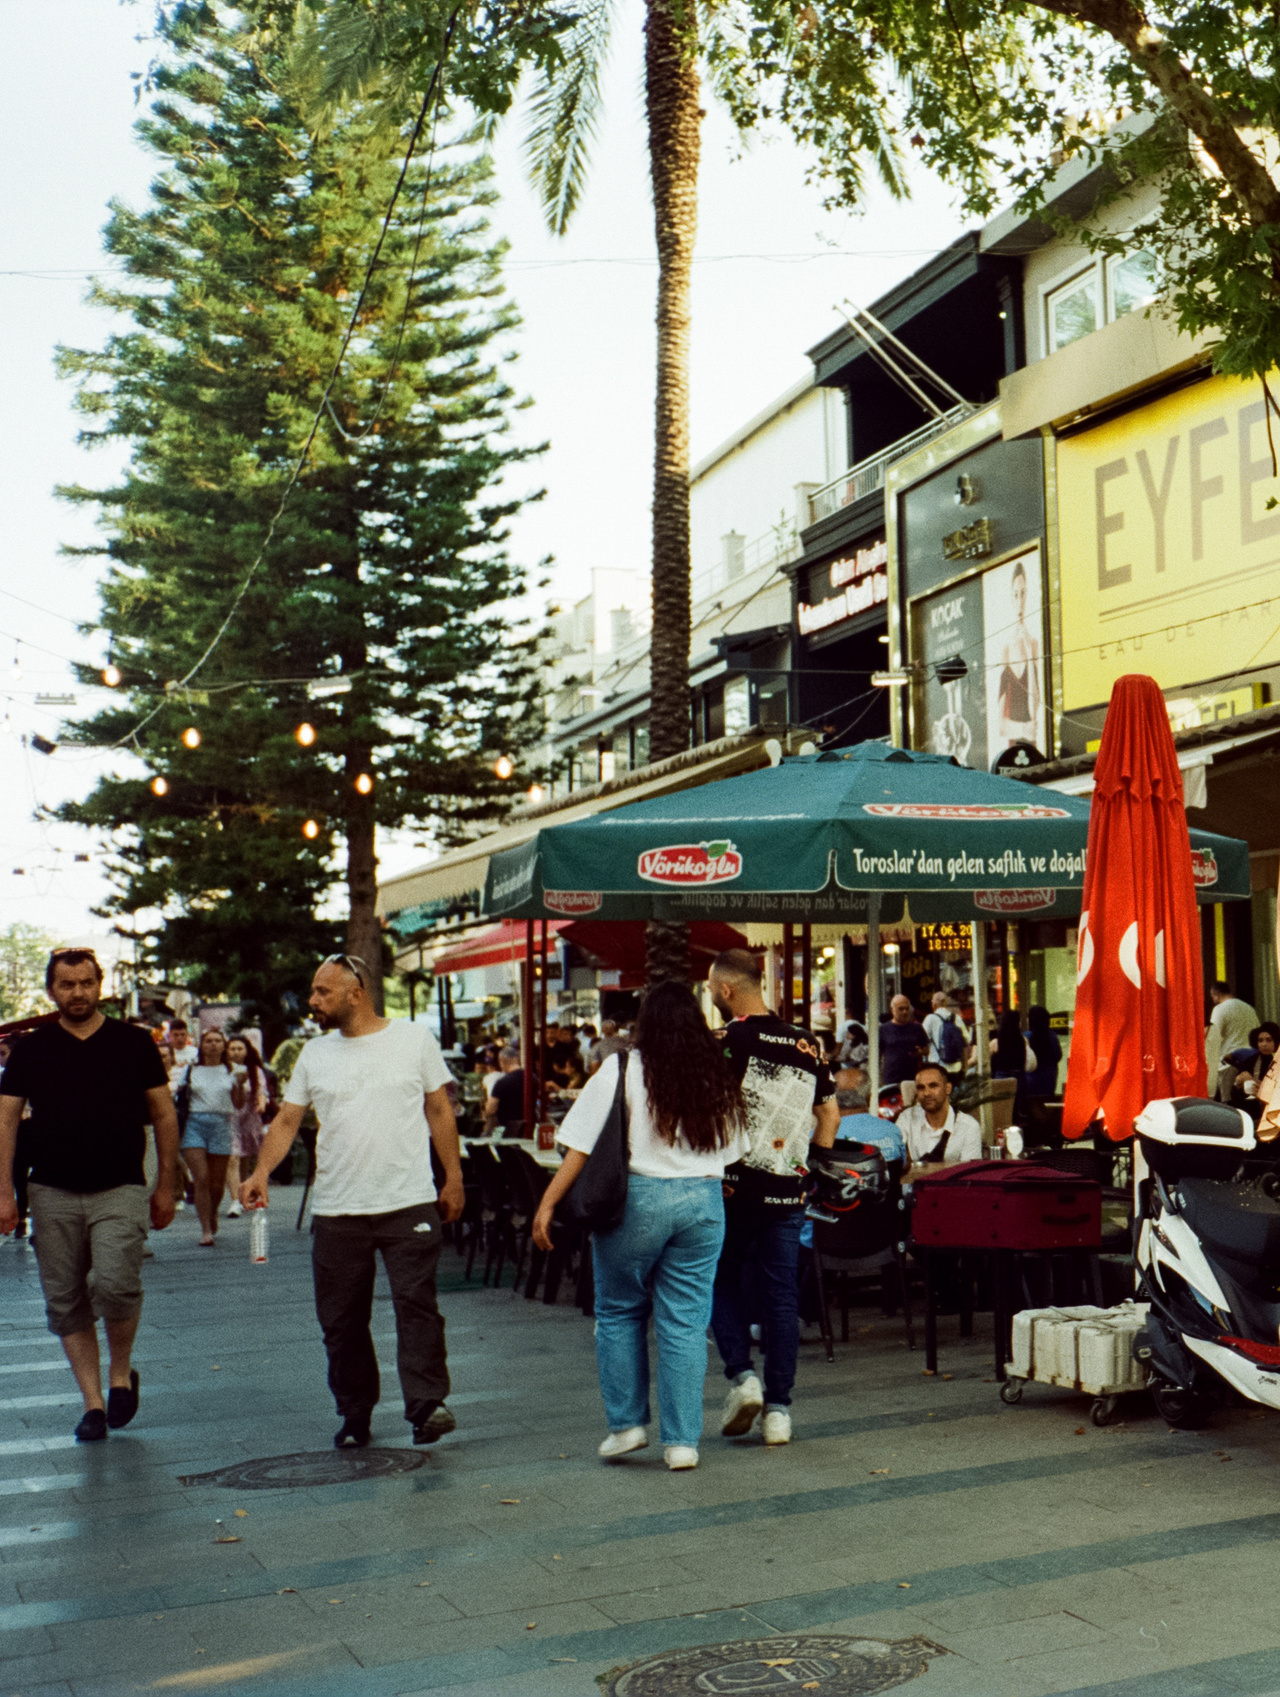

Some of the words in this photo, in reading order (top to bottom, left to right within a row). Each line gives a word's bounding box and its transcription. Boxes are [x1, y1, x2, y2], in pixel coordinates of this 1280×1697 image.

[853, 848, 943, 874] Toroslar'dan
[947, 849, 985, 881] gelen
[988, 849, 1027, 877] saflık
[1030, 858, 1047, 873] ve
[1050, 848, 1089, 880] doğal
